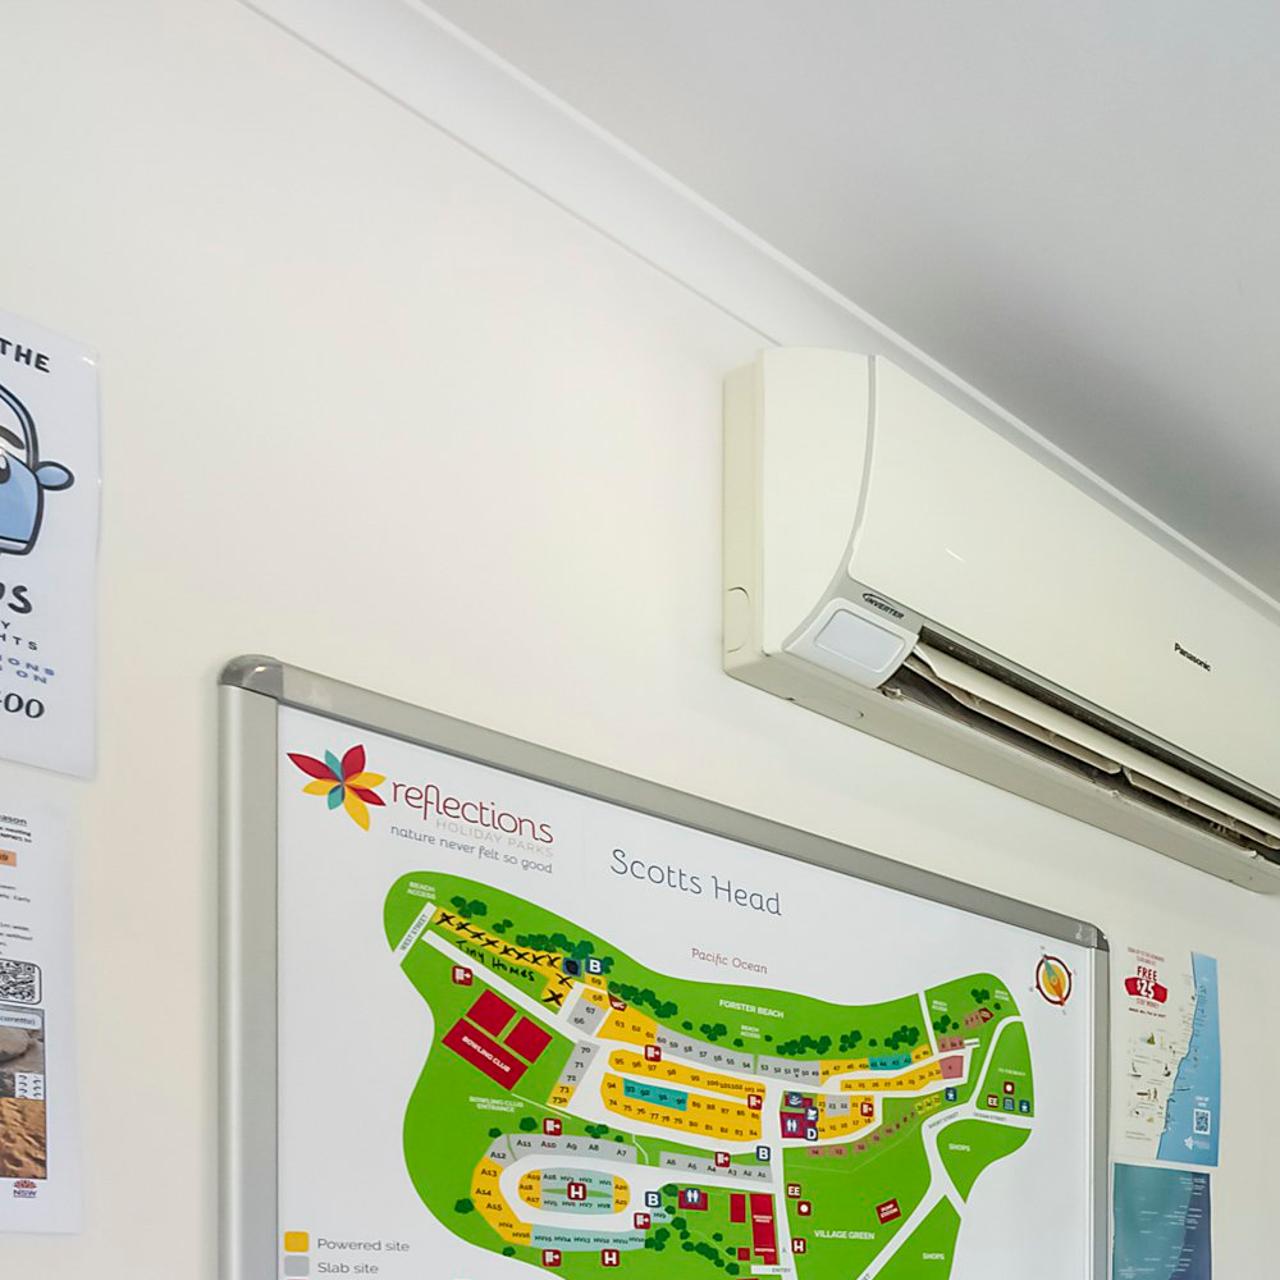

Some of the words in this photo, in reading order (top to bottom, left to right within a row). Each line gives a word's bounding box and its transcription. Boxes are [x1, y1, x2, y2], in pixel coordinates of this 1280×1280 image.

[0, 337, 50, 374] THE
[866, 597, 905, 619] INVERTER
[1174, 642, 1211, 672] Panasonic
[392, 782, 553, 843] reflections
[436, 818, 502, 845] HOLIDAY
[390, 825, 436, 845] nature
[440, 837, 475, 854] never
[478, 845, 499, 860] felt
[504, 854, 518, 865] so
[521, 859, 553, 874] good
[610, 849, 702, 894] Scotts
[711, 875, 782, 916] Head
[691, 948, 729, 967] Pacific
[732, 957, 768, 974] Ocean
[1137, 966, 1157, 982] FREE
[1136, 980, 1155, 999] $25
[719, 999, 757, 1014] FORSTER
[757, 1005, 784, 1018] BEACH
[462, 1035, 492, 1061] BOWLING
[317, 1238, 382, 1251] Powered
[385, 1240, 410, 1252] site
[814, 1230, 847, 1239] VILLAGE
[849, 1231, 875, 1240] GREEN
[317, 1262, 350, 1274] Slab
[353, 1262, 379, 1274] site
